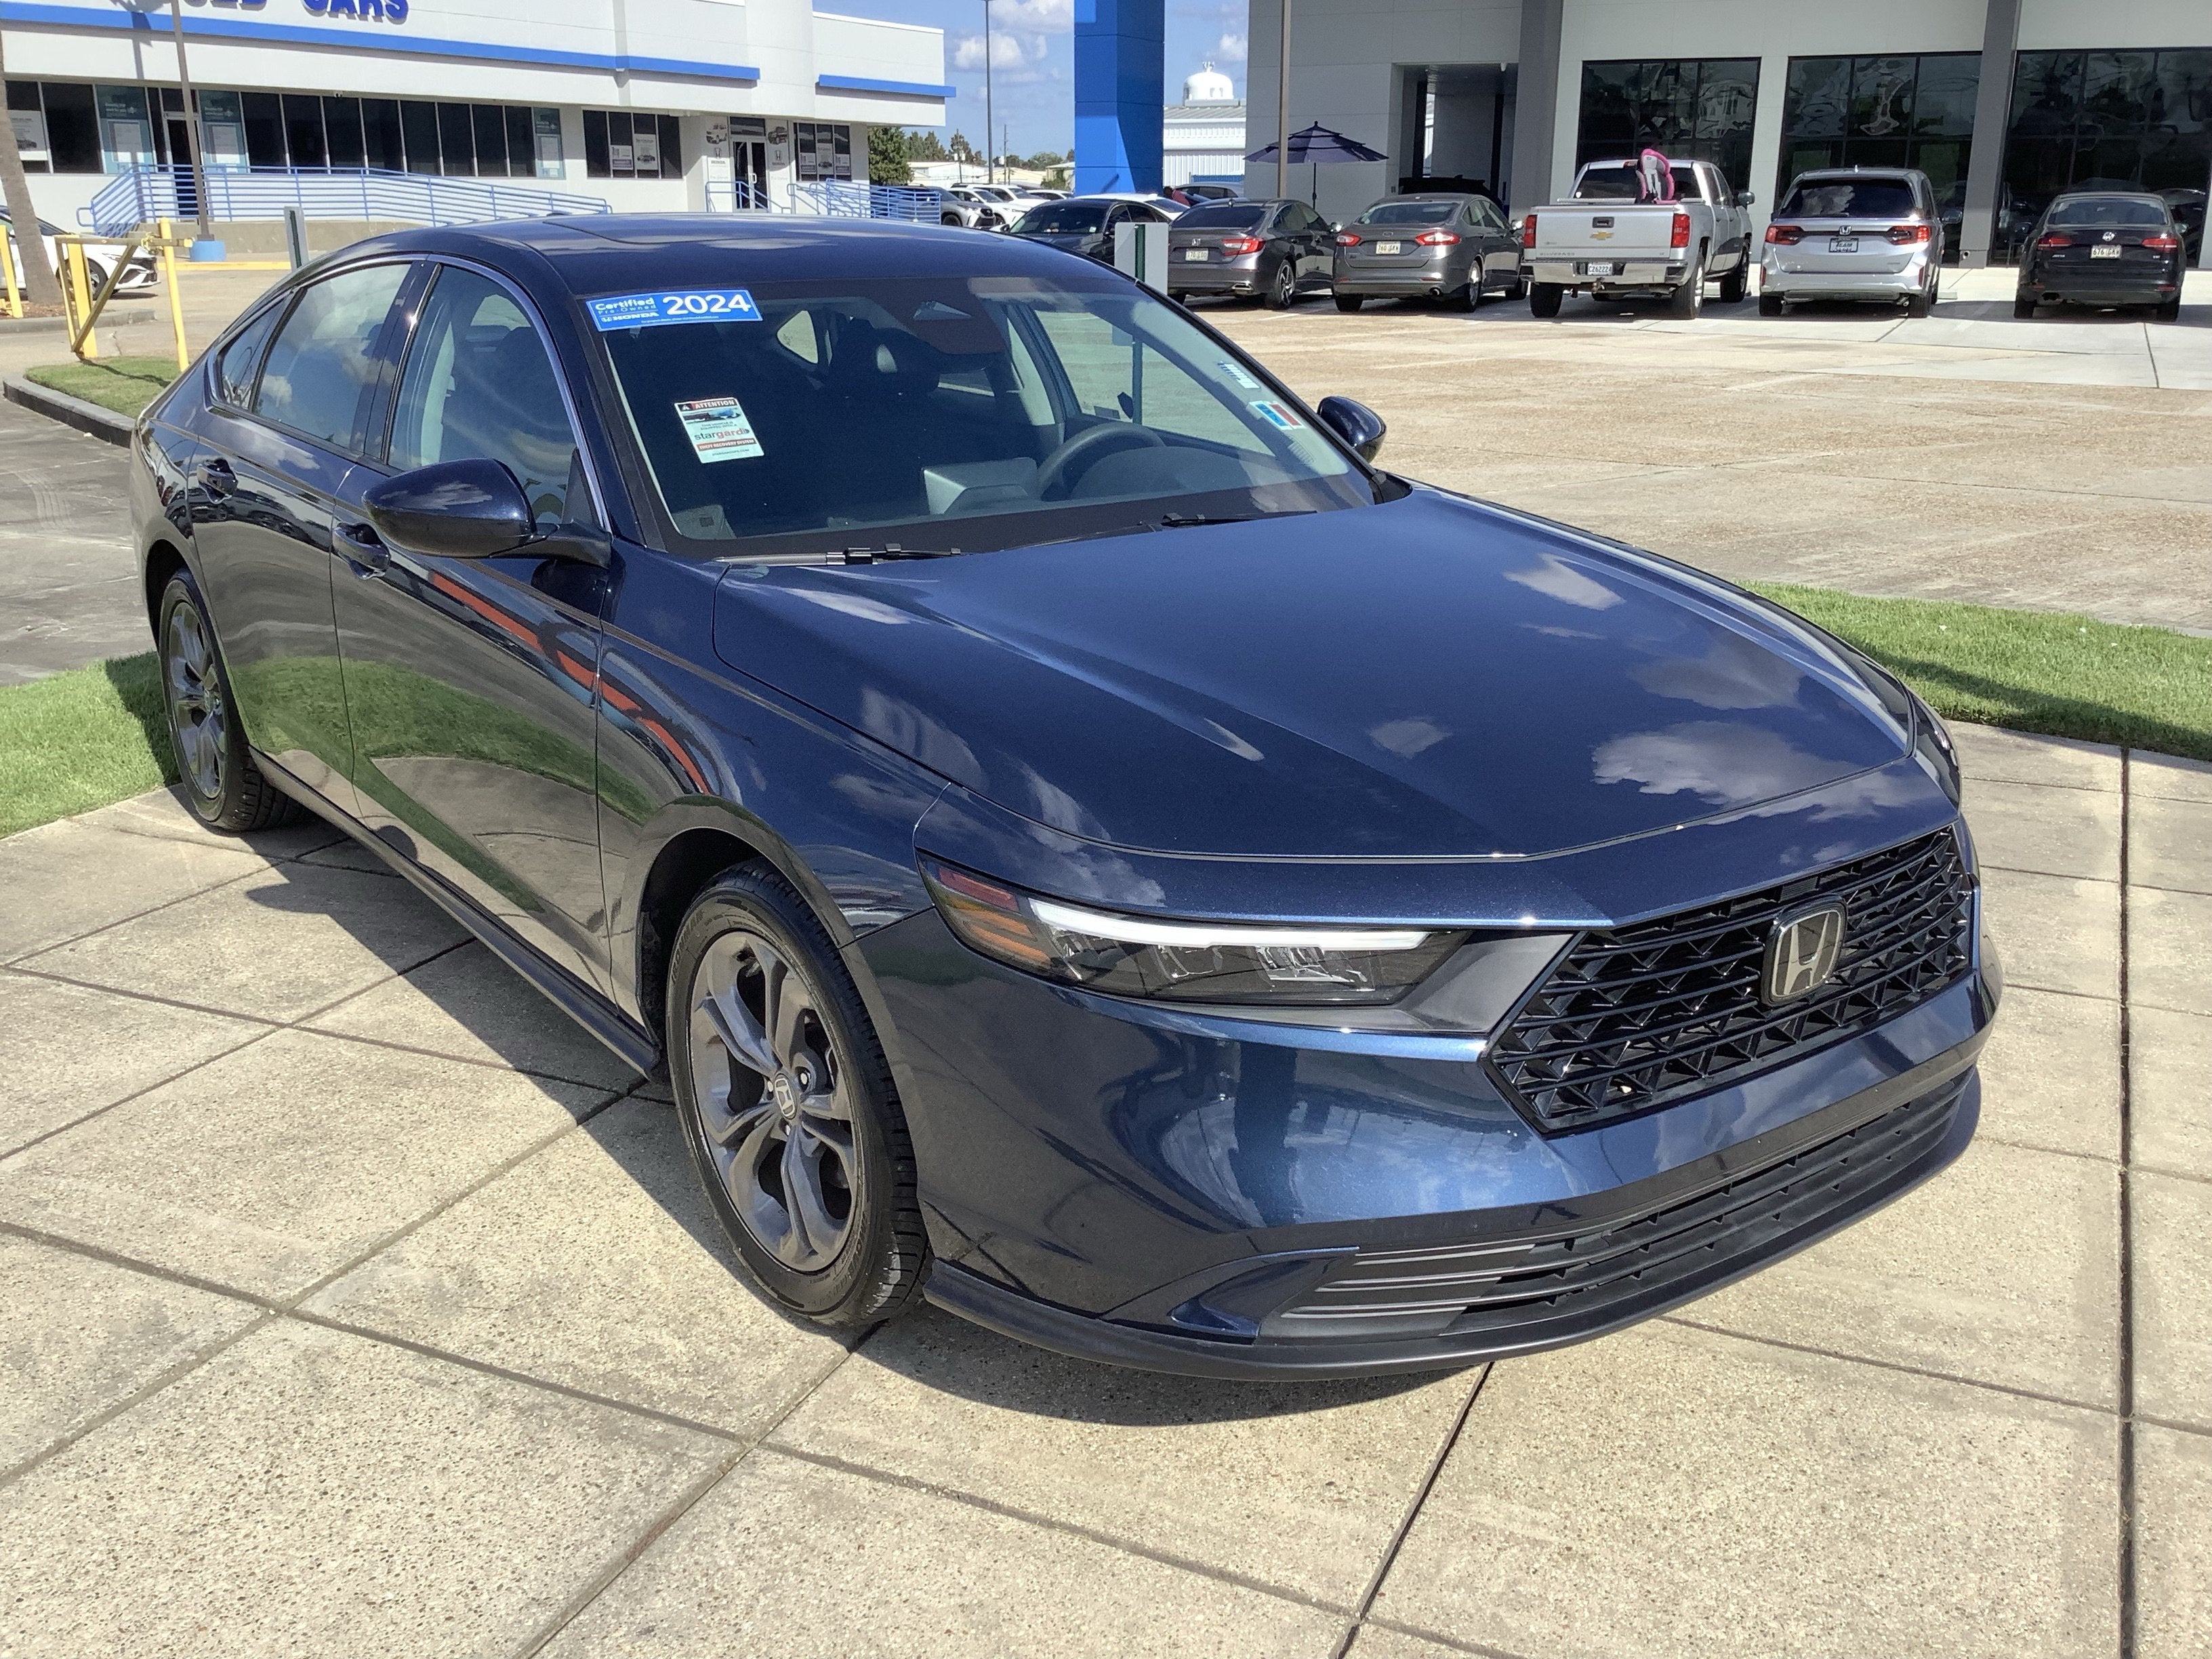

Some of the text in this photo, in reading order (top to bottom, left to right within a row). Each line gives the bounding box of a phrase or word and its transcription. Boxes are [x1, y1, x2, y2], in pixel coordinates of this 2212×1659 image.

[595, 297, 655, 310] Certified
[662, 293, 752, 315] 2024
[612, 312, 659, 321] HONDA
[695, 399, 735, 409] ATTENTION
